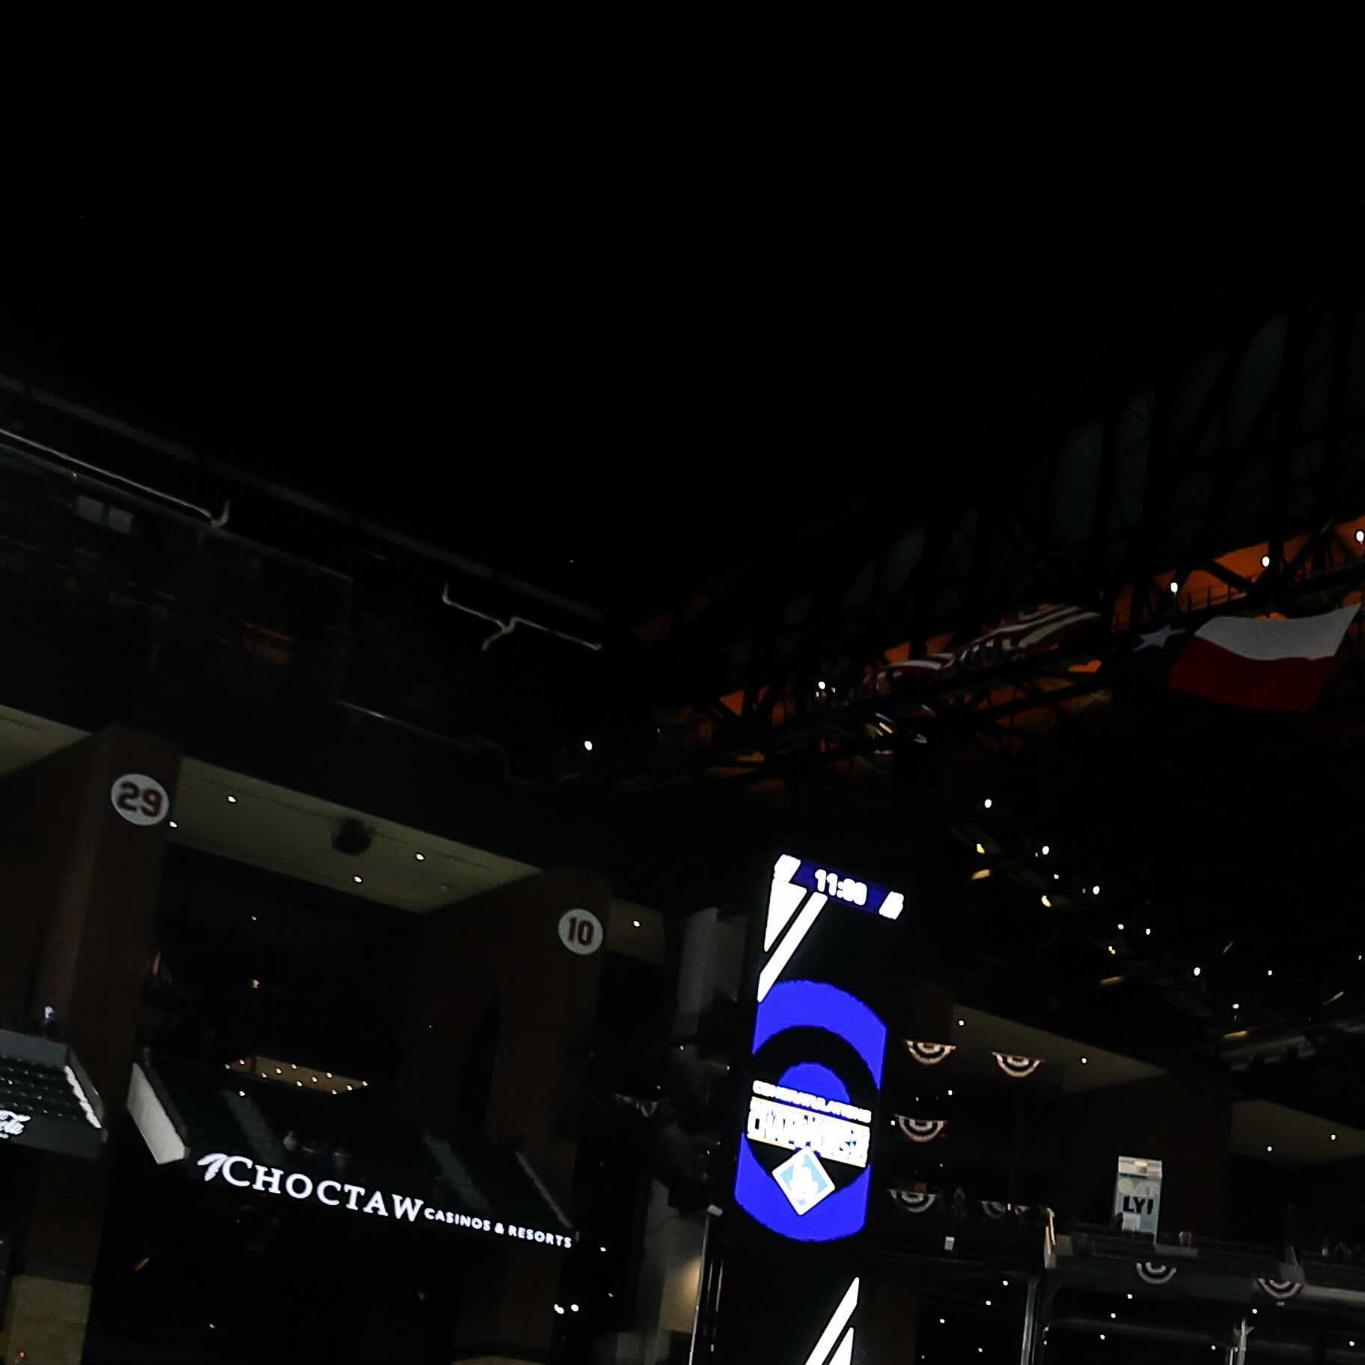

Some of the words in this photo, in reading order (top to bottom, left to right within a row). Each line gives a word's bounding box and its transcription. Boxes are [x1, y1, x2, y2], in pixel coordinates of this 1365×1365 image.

[117, 781, 164, 817] 29
[567, 916, 594, 946] 10
[221, 1155, 425, 1223] CHOCTAW
[424, 1206, 491, 1233] CASINOS
[494, 1221, 504, 1235] &
[508, 1225, 572, 1249] RESORTS
